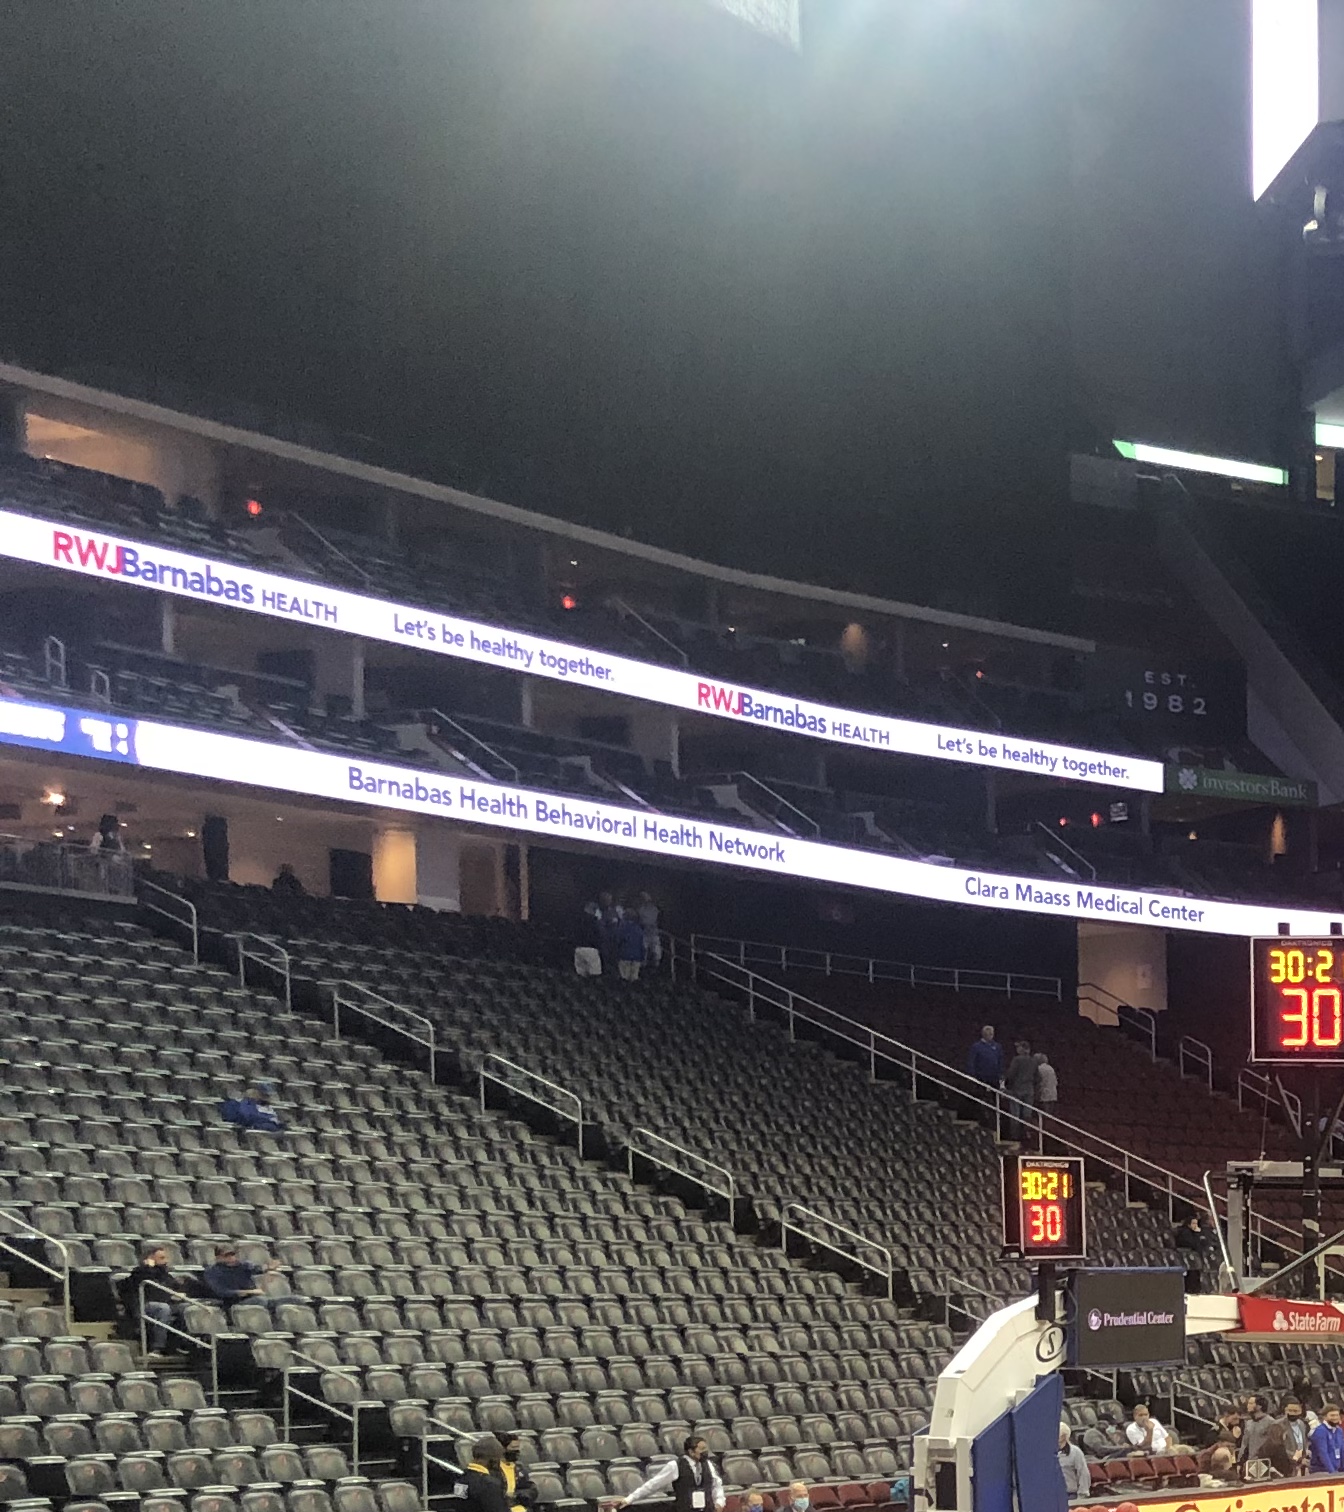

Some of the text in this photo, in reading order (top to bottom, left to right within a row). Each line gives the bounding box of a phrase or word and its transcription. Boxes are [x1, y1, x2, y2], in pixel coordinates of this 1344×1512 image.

[261, 589, 338, 624] HEALTH
[393, 613, 615, 682] Let's be healthy together.
[1125, 690, 1207, 715] 1982
[831, 721, 890, 746] HEALTH
[937, 733, 1130, 780] Let's be healthy together.
[348, 765, 786, 863] Barnabas Health Behavioral Health Network
[964, 876, 1205, 923] Clara Maass Medical Center
[1282, 988, 1341, 1047] 30
[1021, 1171, 1069, 1201] 30:21
[1031, 1205, 1062, 1242] 30
[1103, 1311, 1175, 1327] Prudential Center
